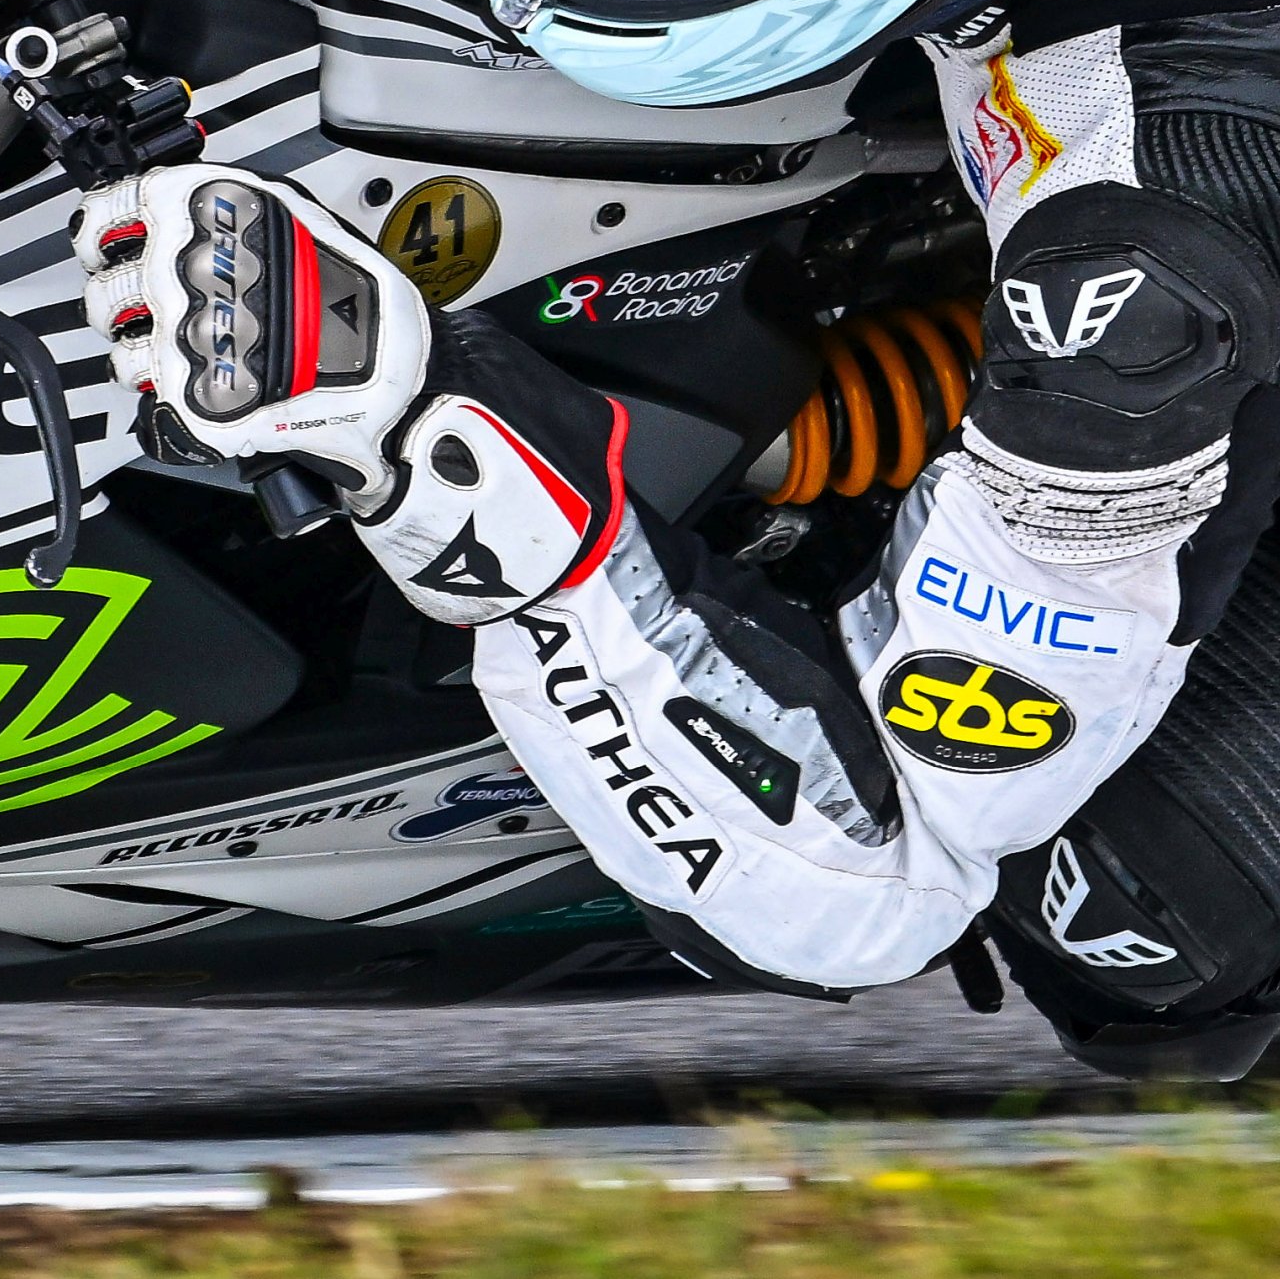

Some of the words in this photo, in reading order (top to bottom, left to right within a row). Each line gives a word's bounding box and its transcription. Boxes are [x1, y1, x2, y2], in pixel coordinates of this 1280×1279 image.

[398, 193, 467, 267] 41
[604, 255, 752, 297] Bonamici
[613, 290, 719, 322] Racing
[290, 418, 328, 431] DESIGN
[884, 665, 1062, 750] sbs
[515, 610, 722, 896] ALTHEA
[455, 787, 540, 801] TERMIGNO
